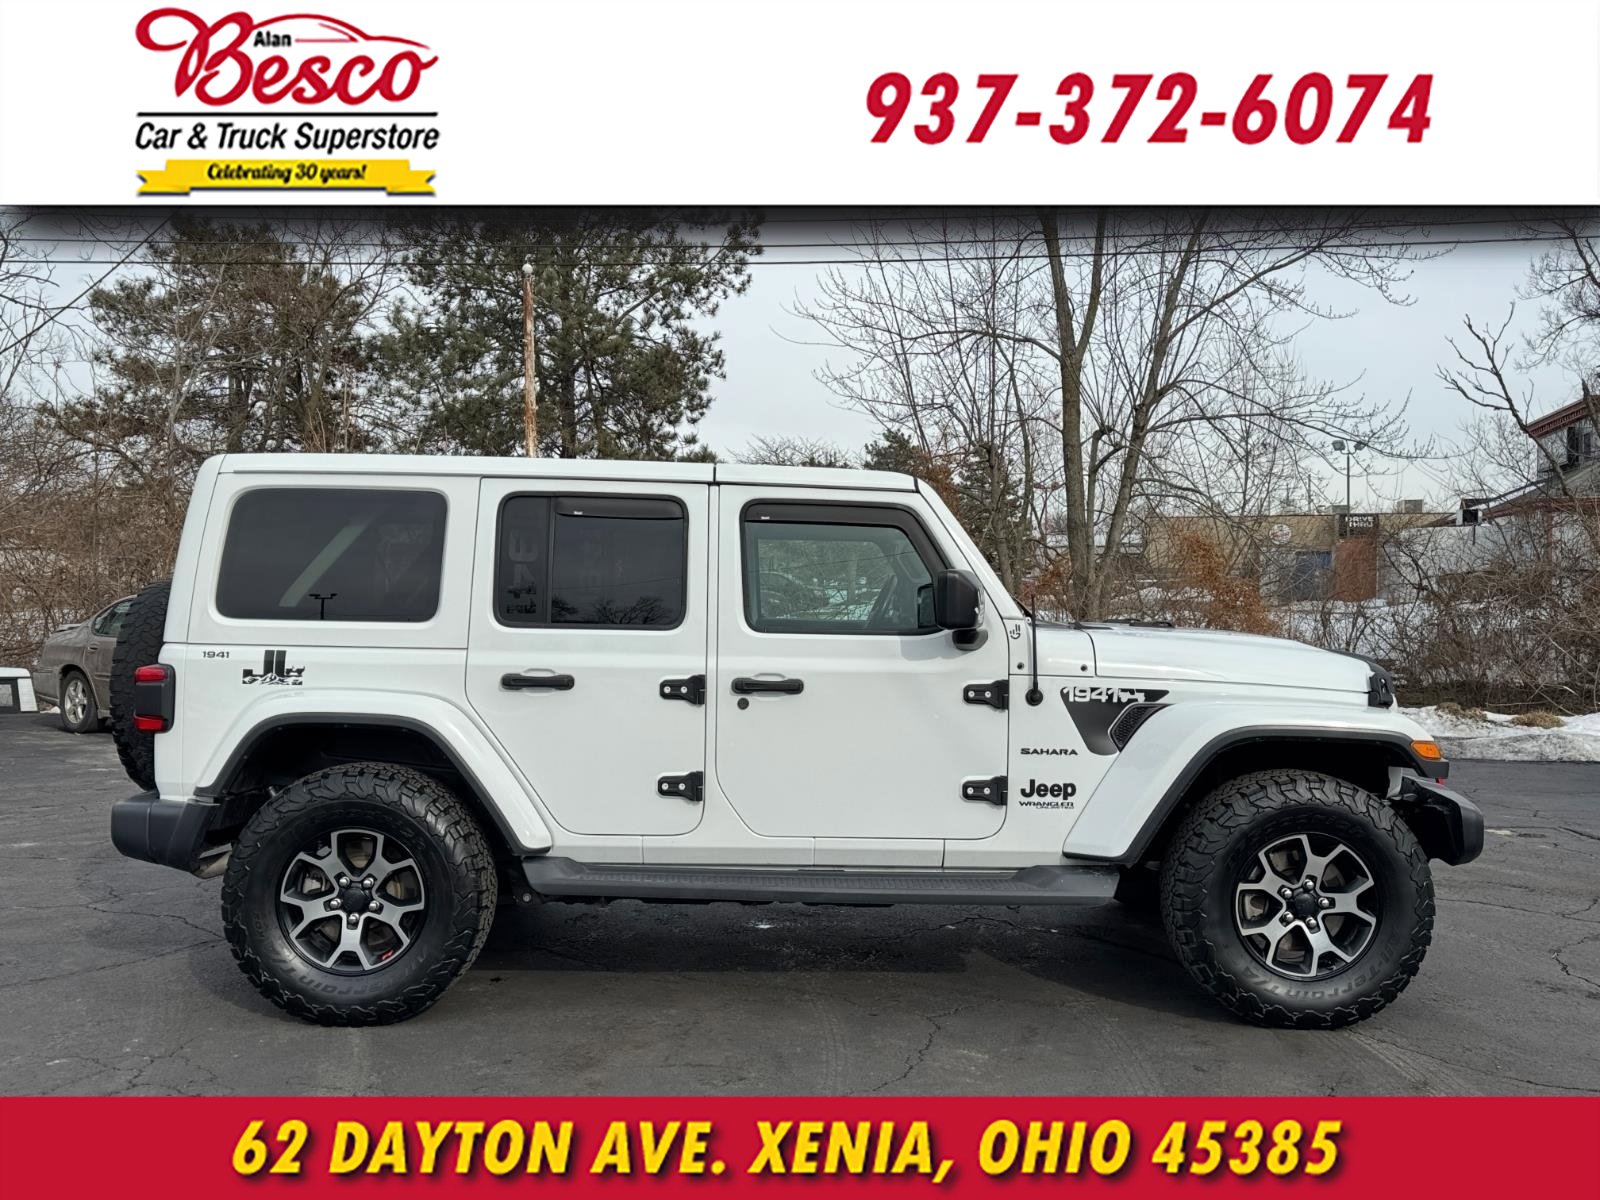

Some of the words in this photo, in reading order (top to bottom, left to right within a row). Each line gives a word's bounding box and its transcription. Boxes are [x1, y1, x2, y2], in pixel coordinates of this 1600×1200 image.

[202, 650, 230, 659] 1941
[1062, 686, 1119, 703] 1941
[1020, 747, 1078, 756] SAHARA
[1020, 778, 1077, 801] Jeep
